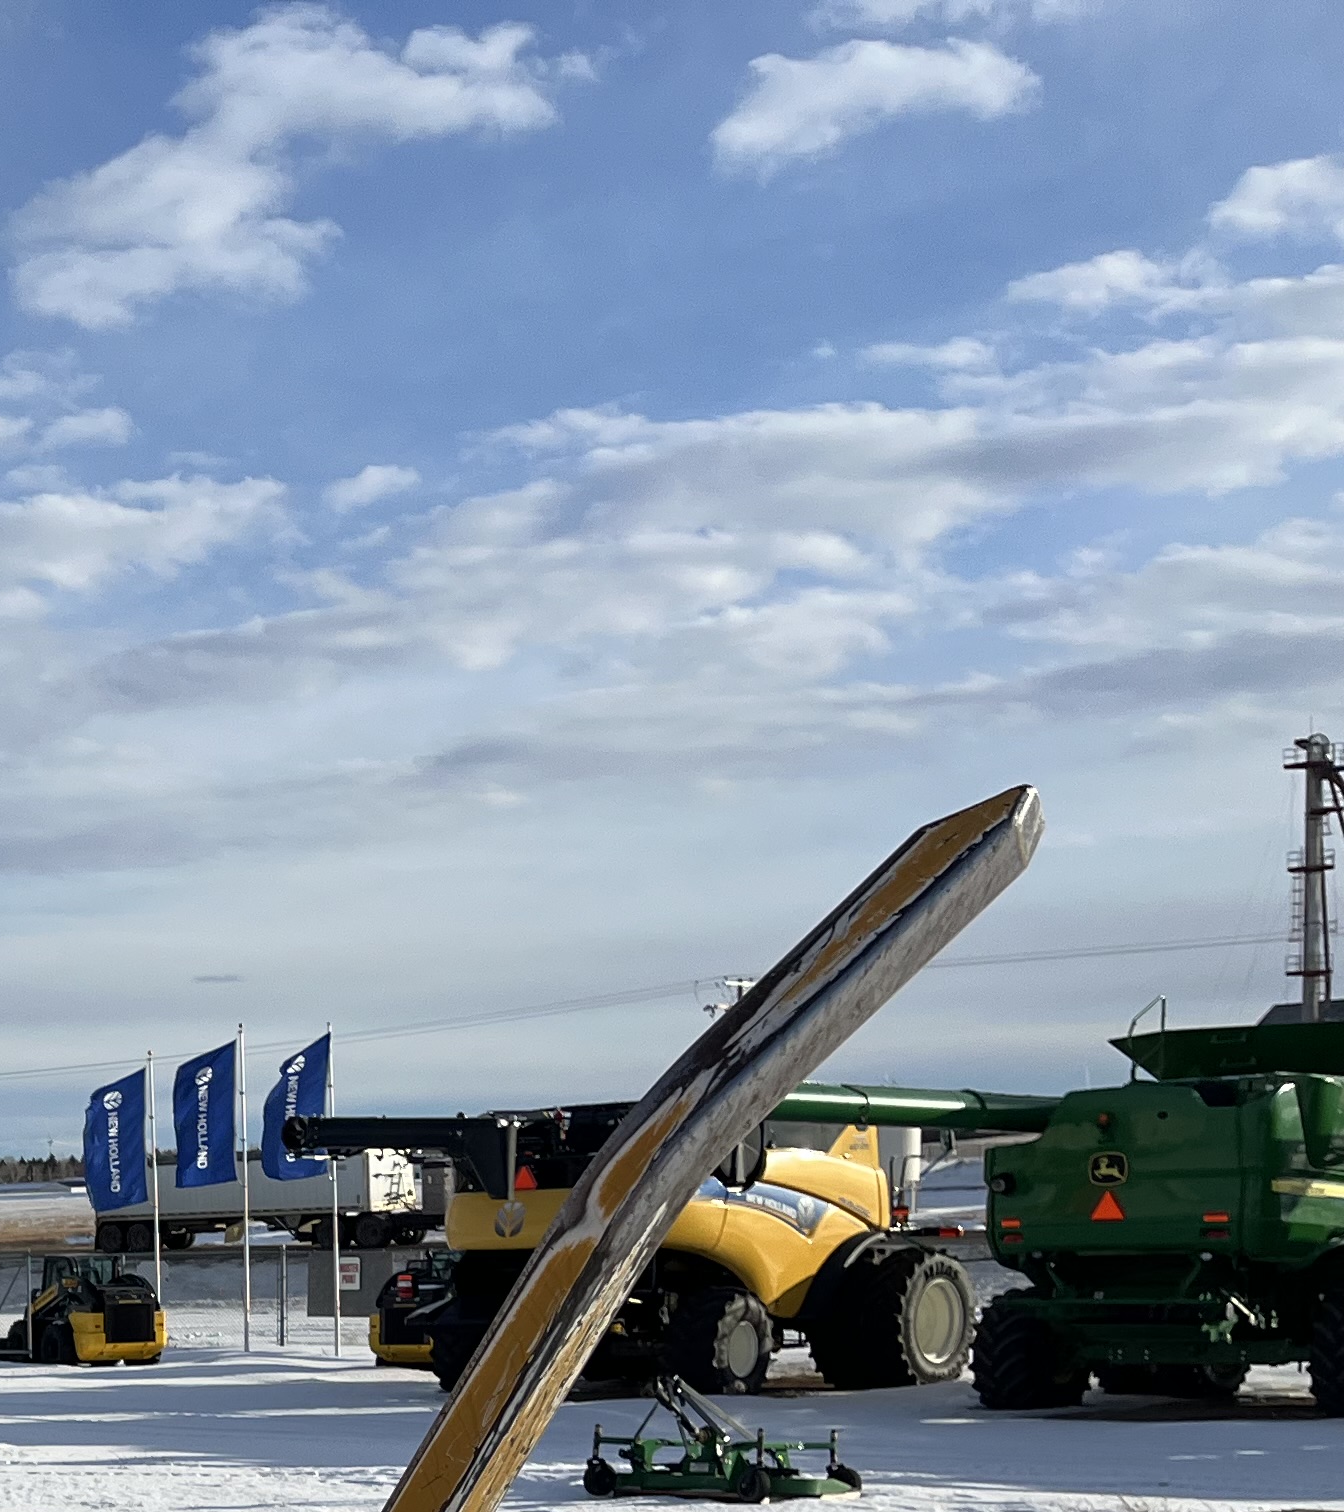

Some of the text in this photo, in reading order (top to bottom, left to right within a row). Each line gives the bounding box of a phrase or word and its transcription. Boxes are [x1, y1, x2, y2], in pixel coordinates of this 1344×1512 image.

[196, 1084, 210, 1170] NEW HOLLAND
[285, 1075, 300, 1103] NEW
[107, 1111, 121, 1193] NEW HOLLAND
